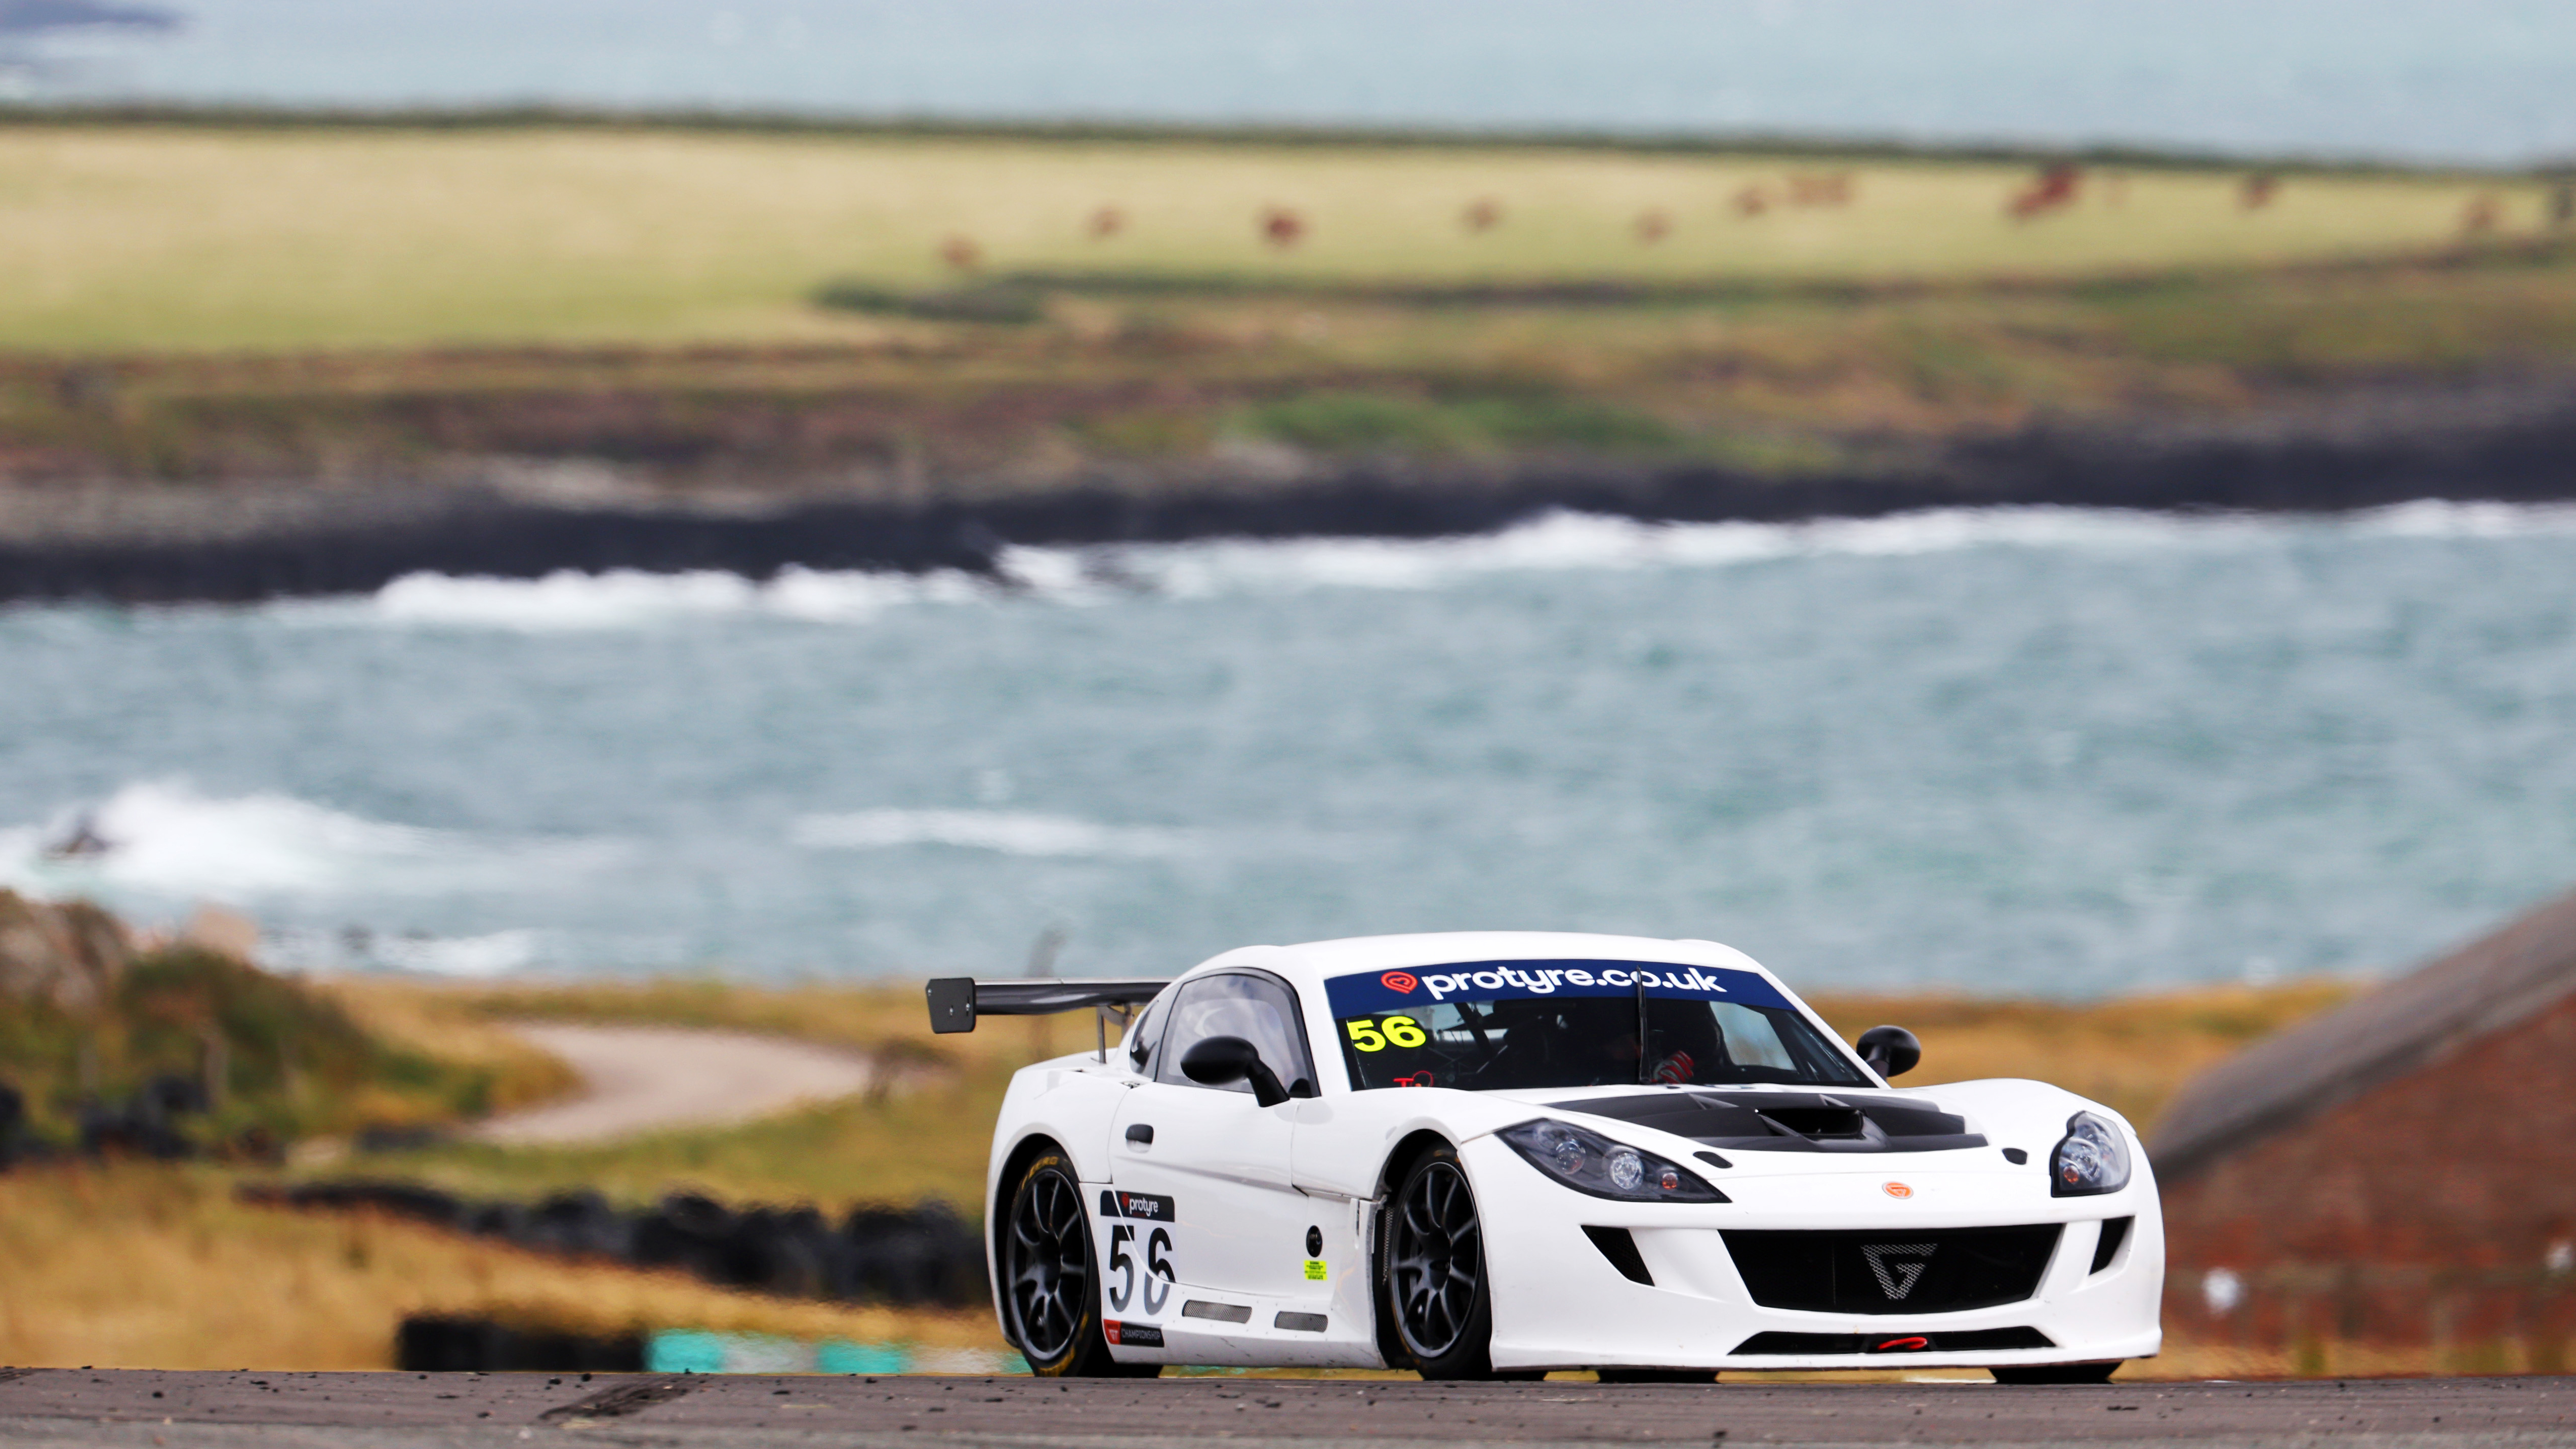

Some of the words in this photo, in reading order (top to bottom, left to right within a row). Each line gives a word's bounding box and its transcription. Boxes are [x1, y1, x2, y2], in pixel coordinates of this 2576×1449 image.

[1421, 966, 1727, 1000] protyre.co.uk
[1347, 1016, 1426, 1052] 56
[1129, 1197, 1158, 1217] protyre
[1109, 1225, 1176, 1315] 56
[1121, 1328, 1160, 1340] CHAMPIONSHIP
